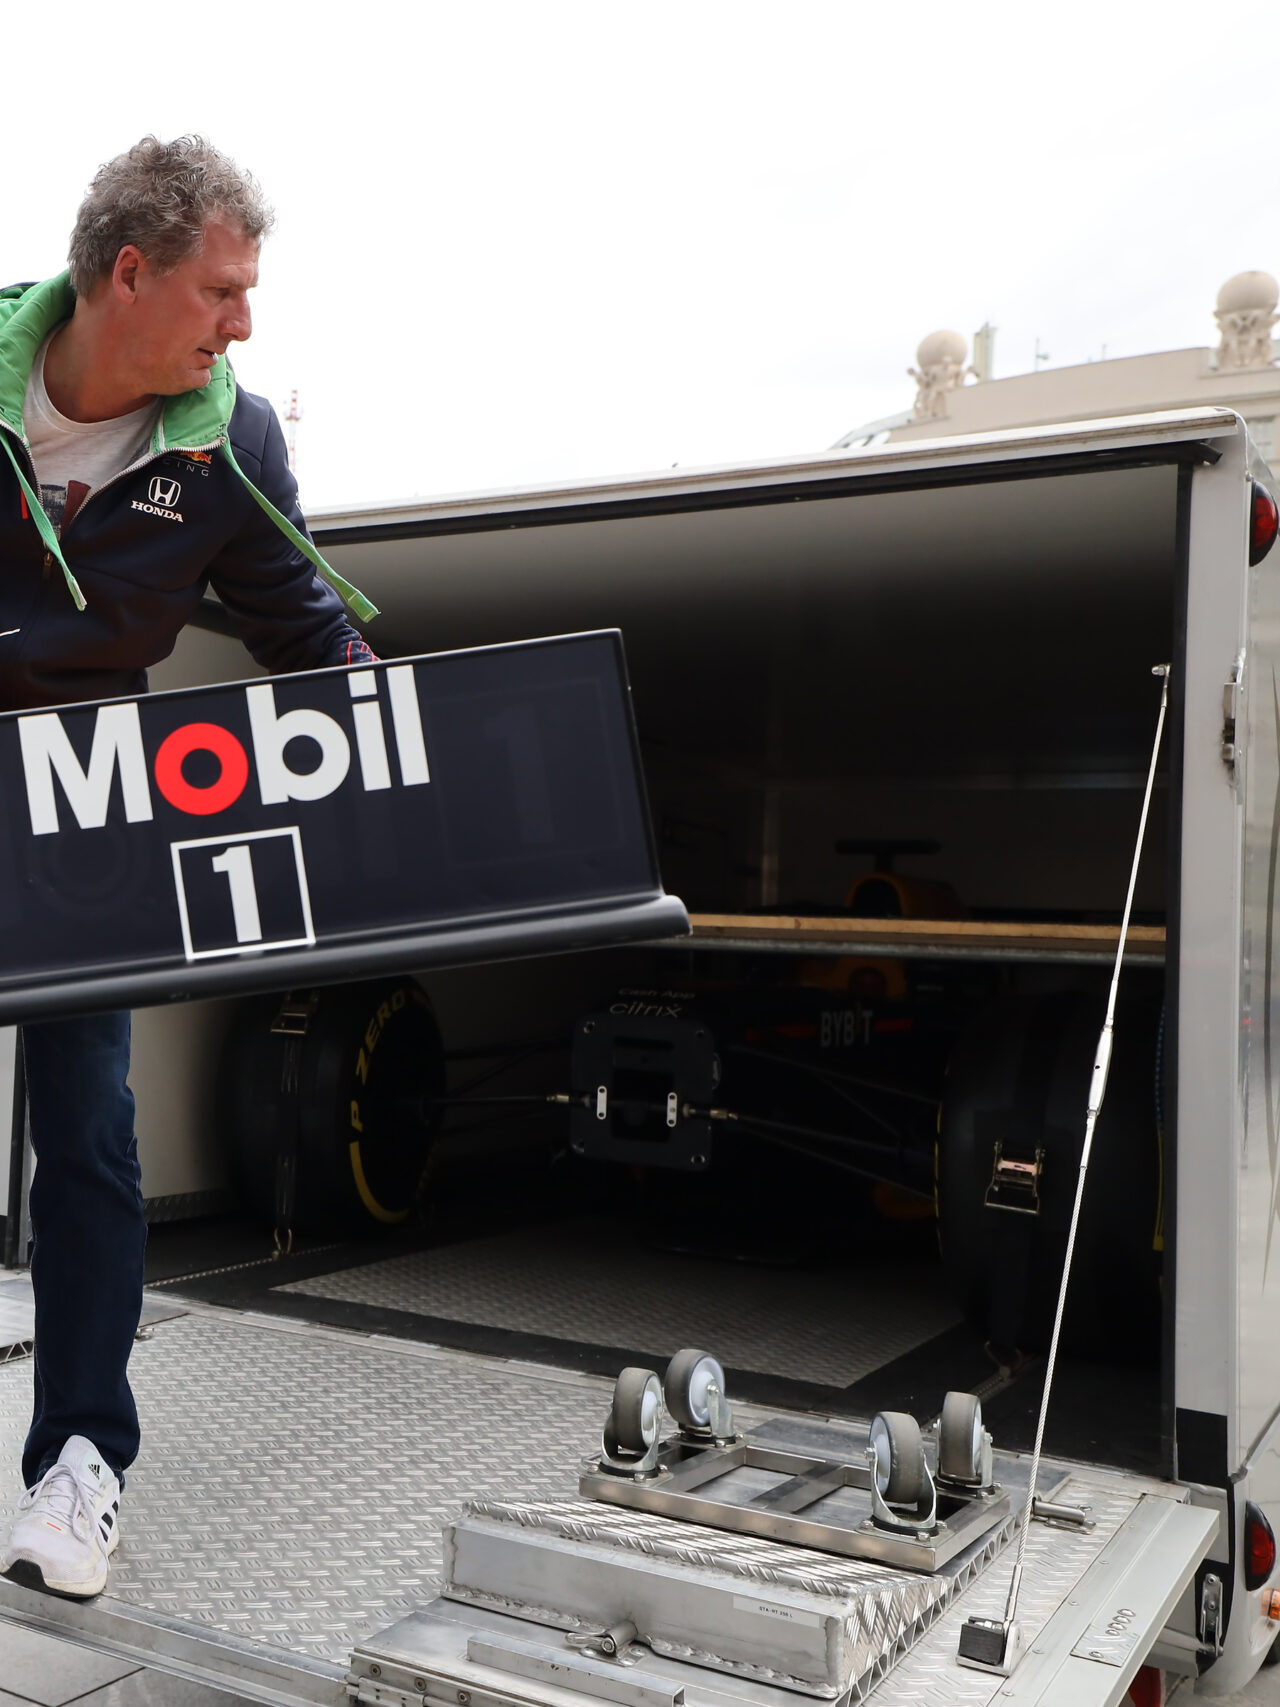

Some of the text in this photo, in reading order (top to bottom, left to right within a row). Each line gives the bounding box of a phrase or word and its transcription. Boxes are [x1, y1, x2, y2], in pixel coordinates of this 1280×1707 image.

[130, 500, 184, 523] HONDA
[17, 664, 431, 836] Mobil
[211, 845, 263, 943] 1
[354, 987, 407, 1088] ZERO
[609, 1000, 683, 1019] citrix
